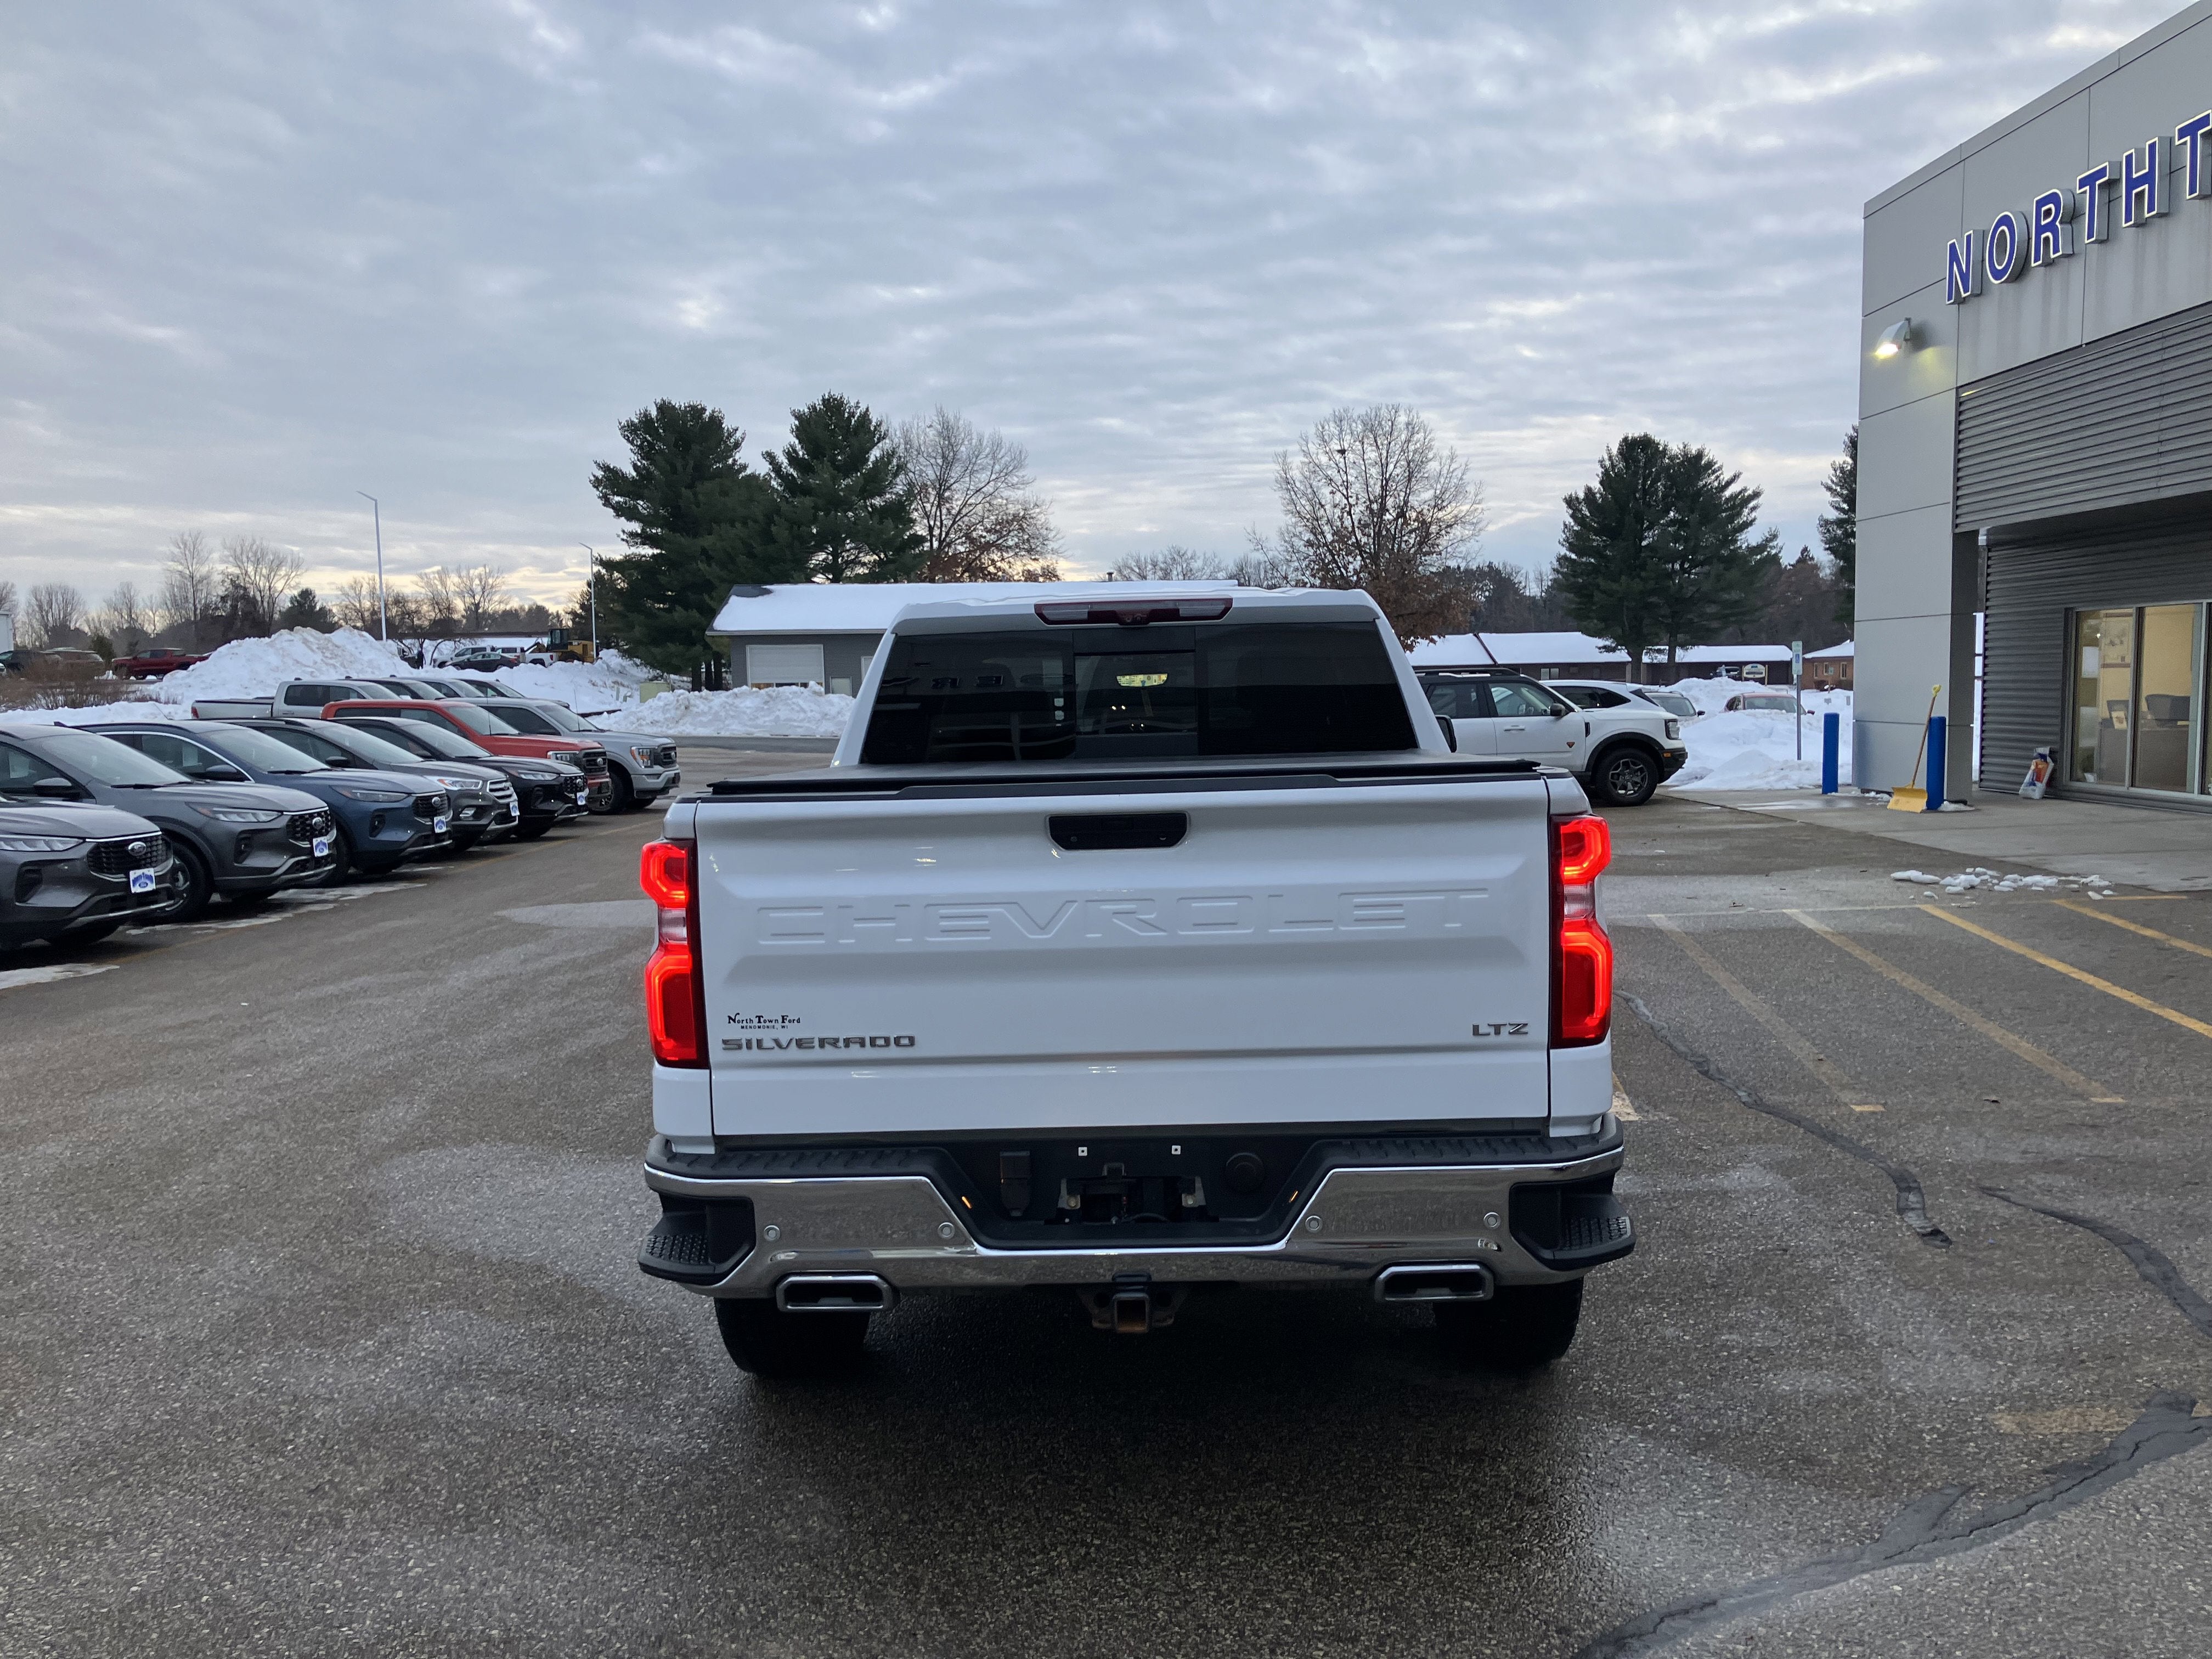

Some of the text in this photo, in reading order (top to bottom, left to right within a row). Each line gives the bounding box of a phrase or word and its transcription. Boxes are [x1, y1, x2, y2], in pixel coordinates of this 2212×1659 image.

[1945, 109, 2212, 305] NORTHT
[757, 887, 1489, 945] CHEVROLET
[727, 1012, 801, 1024] North Town Ford
[1472, 1023, 1528, 1036] LTZ
[721, 1035, 916, 1051] SILVERADO
